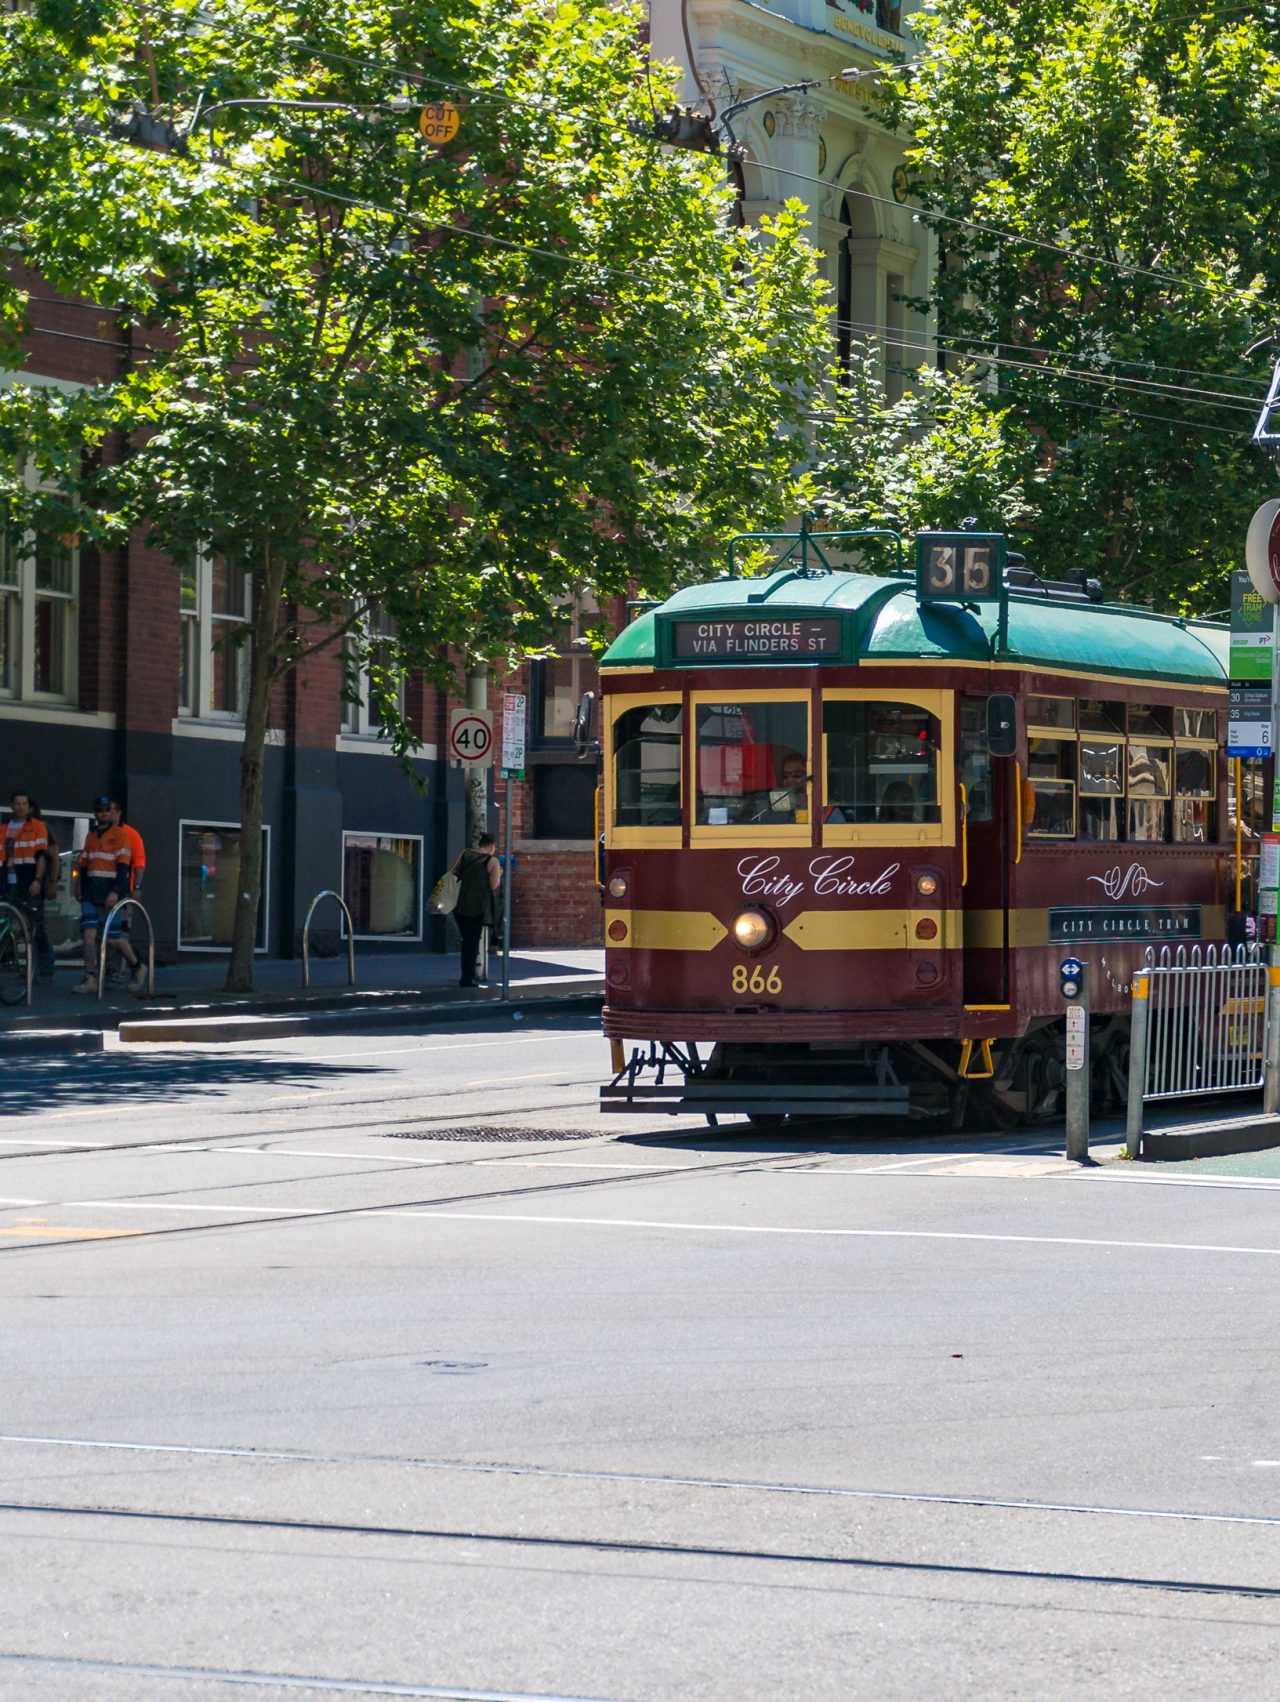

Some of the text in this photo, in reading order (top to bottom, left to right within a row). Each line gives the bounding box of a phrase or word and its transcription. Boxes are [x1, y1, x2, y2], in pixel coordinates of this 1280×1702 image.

[425, 106, 455, 121] CUT
[424, 123, 453, 138] OFF
[930, 546, 990, 589] 35
[1242, 593, 1263, 602] FREE
[1242, 602, 1263, 612] TRAM
[1243, 611, 1262, 622] ZONE
[698, 624, 735, 637] CITY
[744, 623, 801, 636] CIRCLE
[693, 637, 827, 652] VIA FLINDERS ST
[516, 696, 524, 707] 2P
[1231, 693, 1241, 703] 30
[1230, 709, 1240, 719] 35
[456, 728, 487, 750] 40
[1262, 731, 1269, 744] 6
[515, 747, 523, 759] 2P
[737, 855, 900, 907] City Circle
[1063, 918, 1189, 933] CITY CIRCLE TRAM
[731, 964, 783, 994] 866
